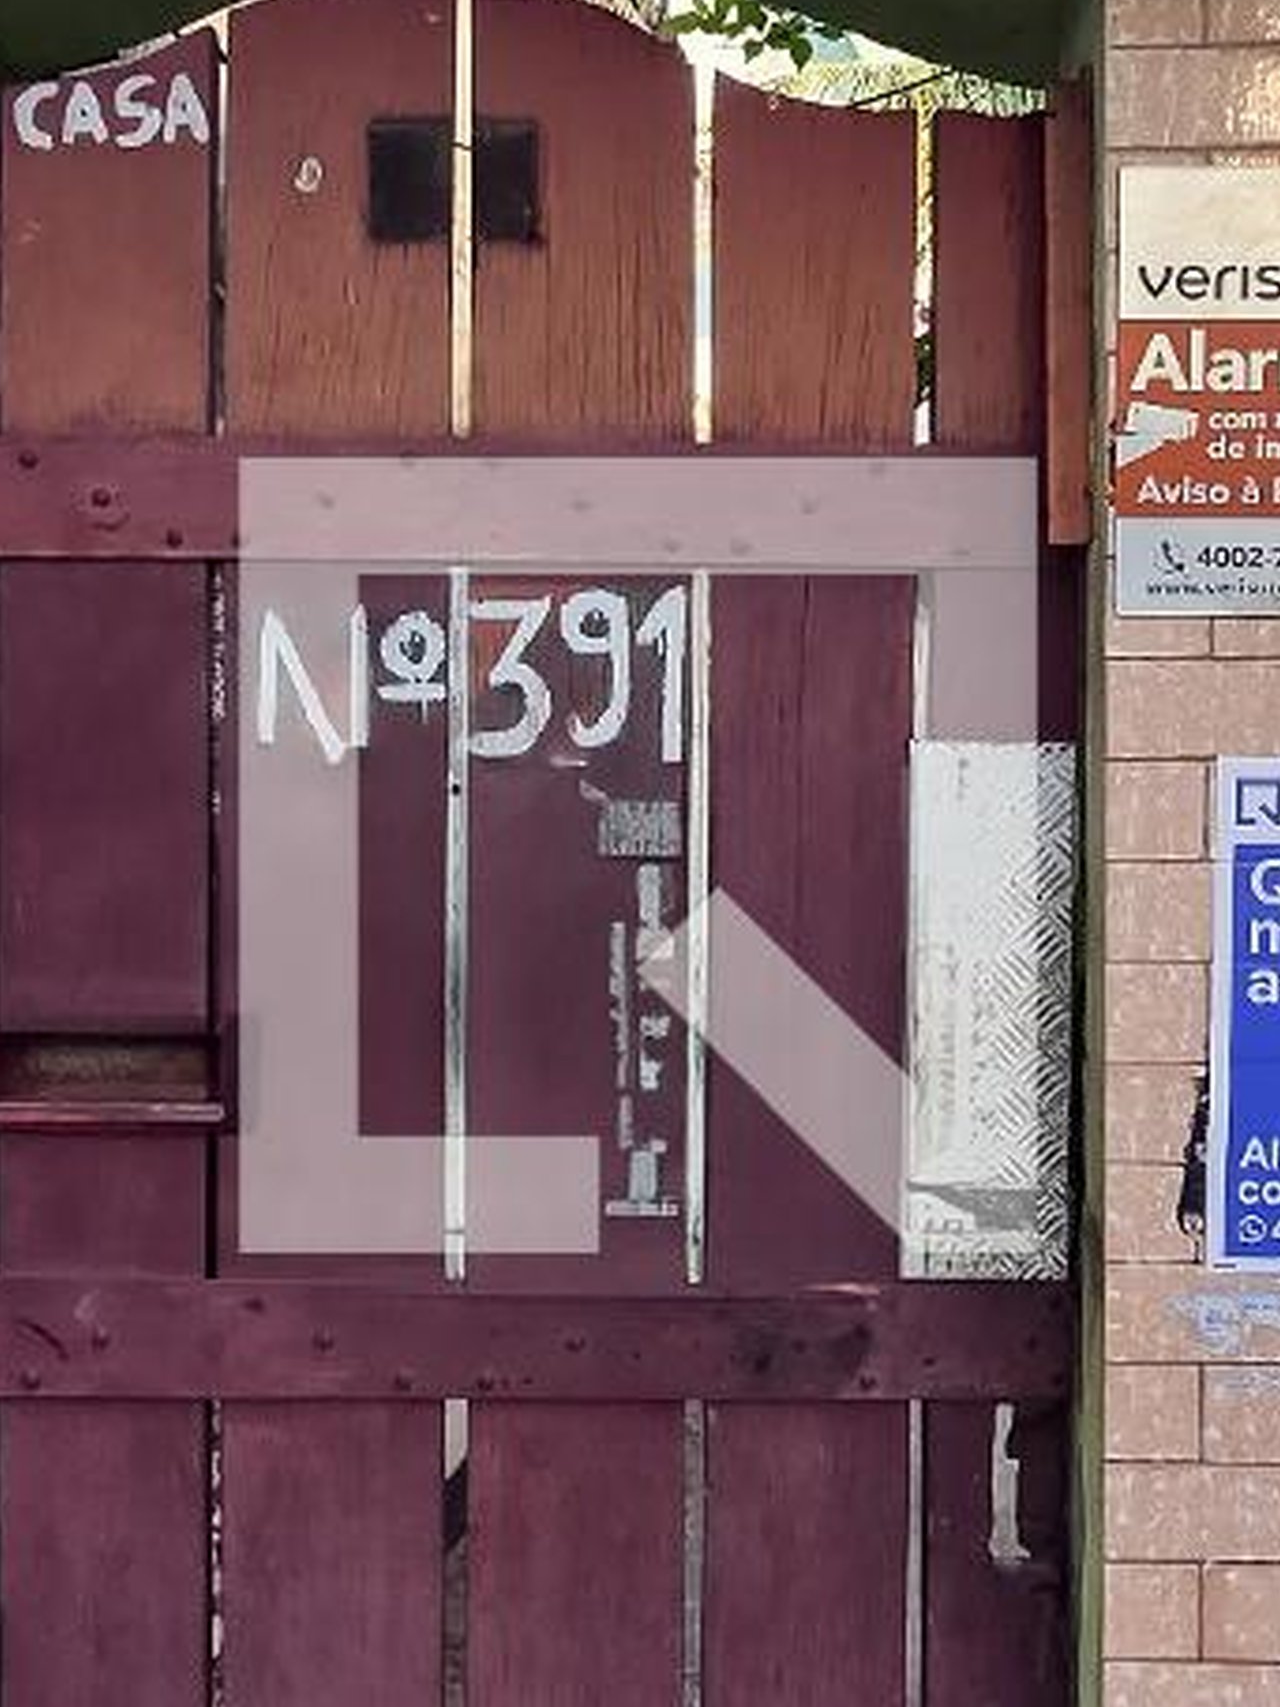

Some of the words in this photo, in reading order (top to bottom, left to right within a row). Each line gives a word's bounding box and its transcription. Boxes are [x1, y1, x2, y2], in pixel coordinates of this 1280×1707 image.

[12, 72, 211, 151] CASA
[1207, 409, 1268, 432] com
[1206, 433, 1246, 461] de
[1136, 474, 1231, 506] Aviso
[1240, 471, 1261, 505] à
